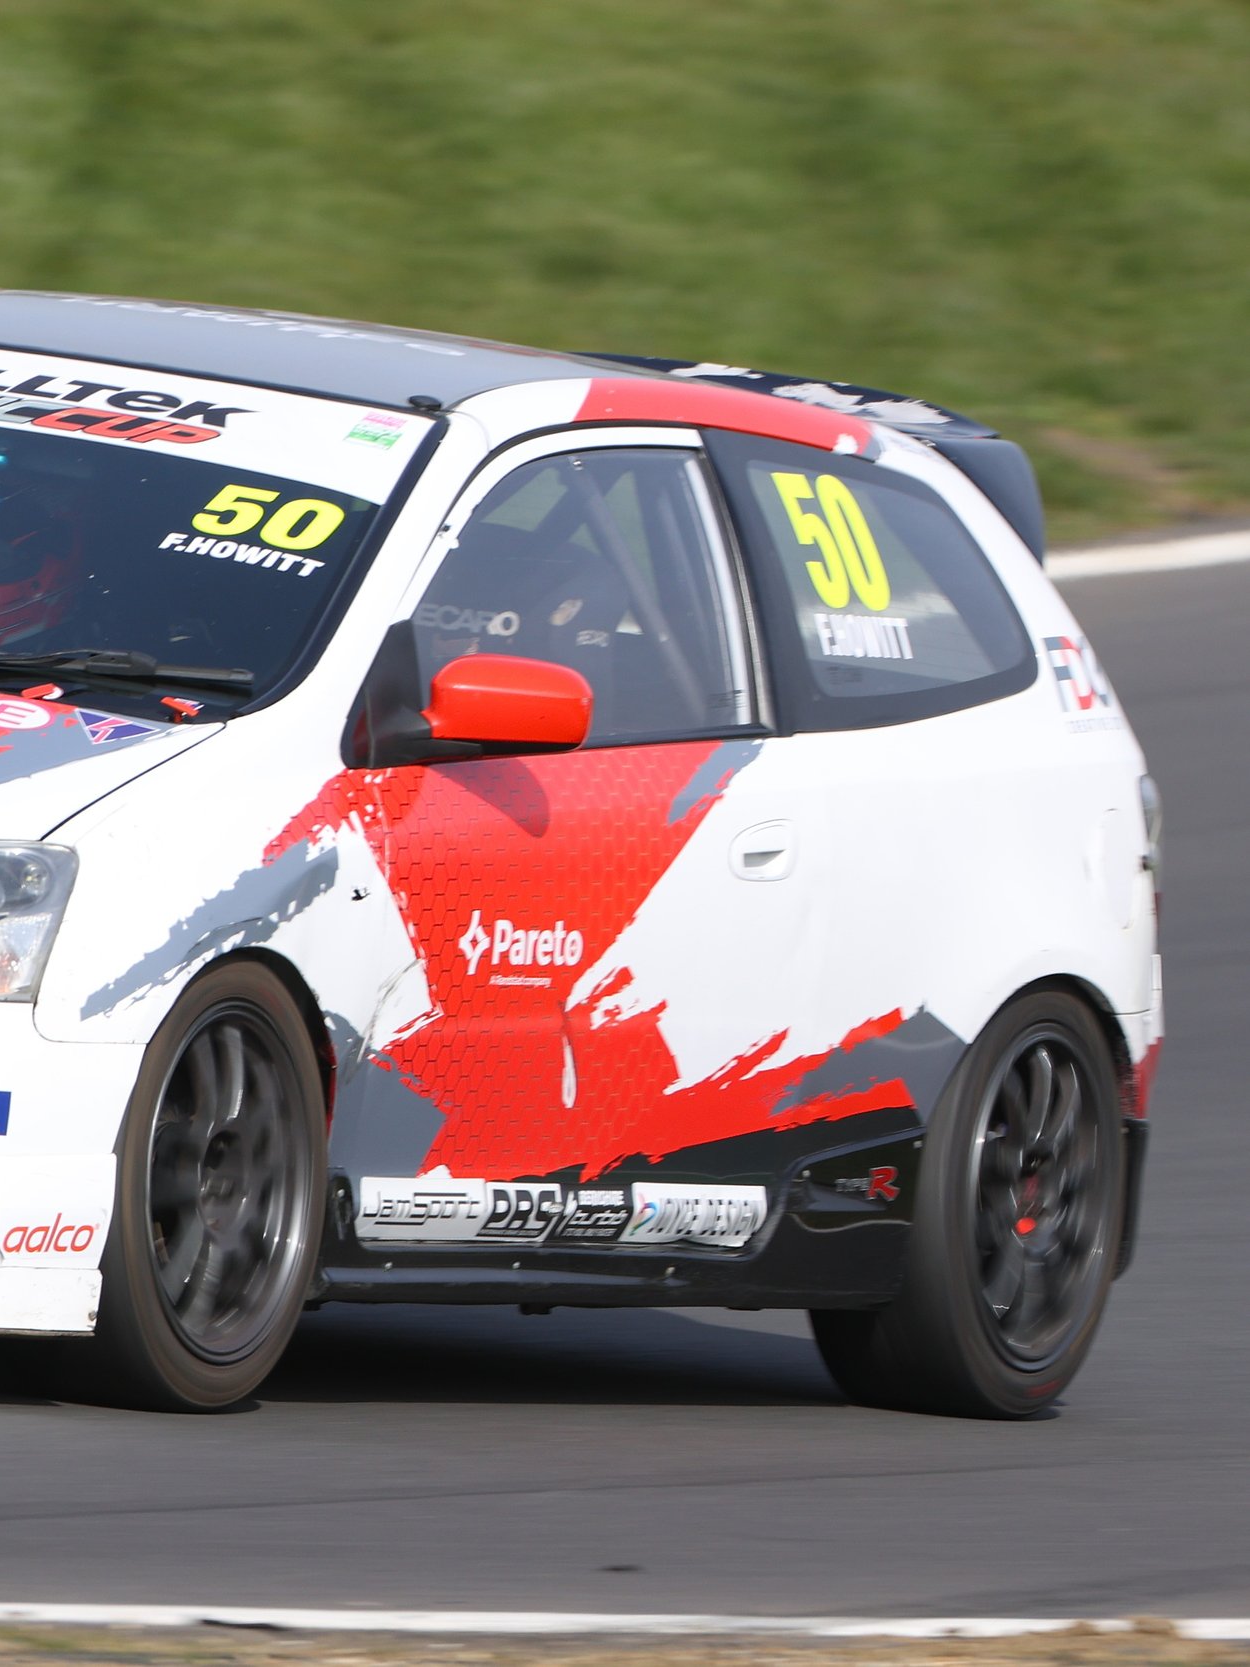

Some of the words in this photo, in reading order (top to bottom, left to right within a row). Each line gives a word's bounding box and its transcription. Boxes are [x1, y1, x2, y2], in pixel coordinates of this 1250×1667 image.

[30, 406, 223, 445] CUP
[190, 483, 346, 552] 50
[157, 532, 326, 578] F.HOWITT
[771, 471, 892, 612] 50
[414, 602, 521, 637] ECARO
[491, 919, 584, 967] Pareto
[865, 1166, 900, 1201] R
[2, 1212, 94, 1253] aalco
